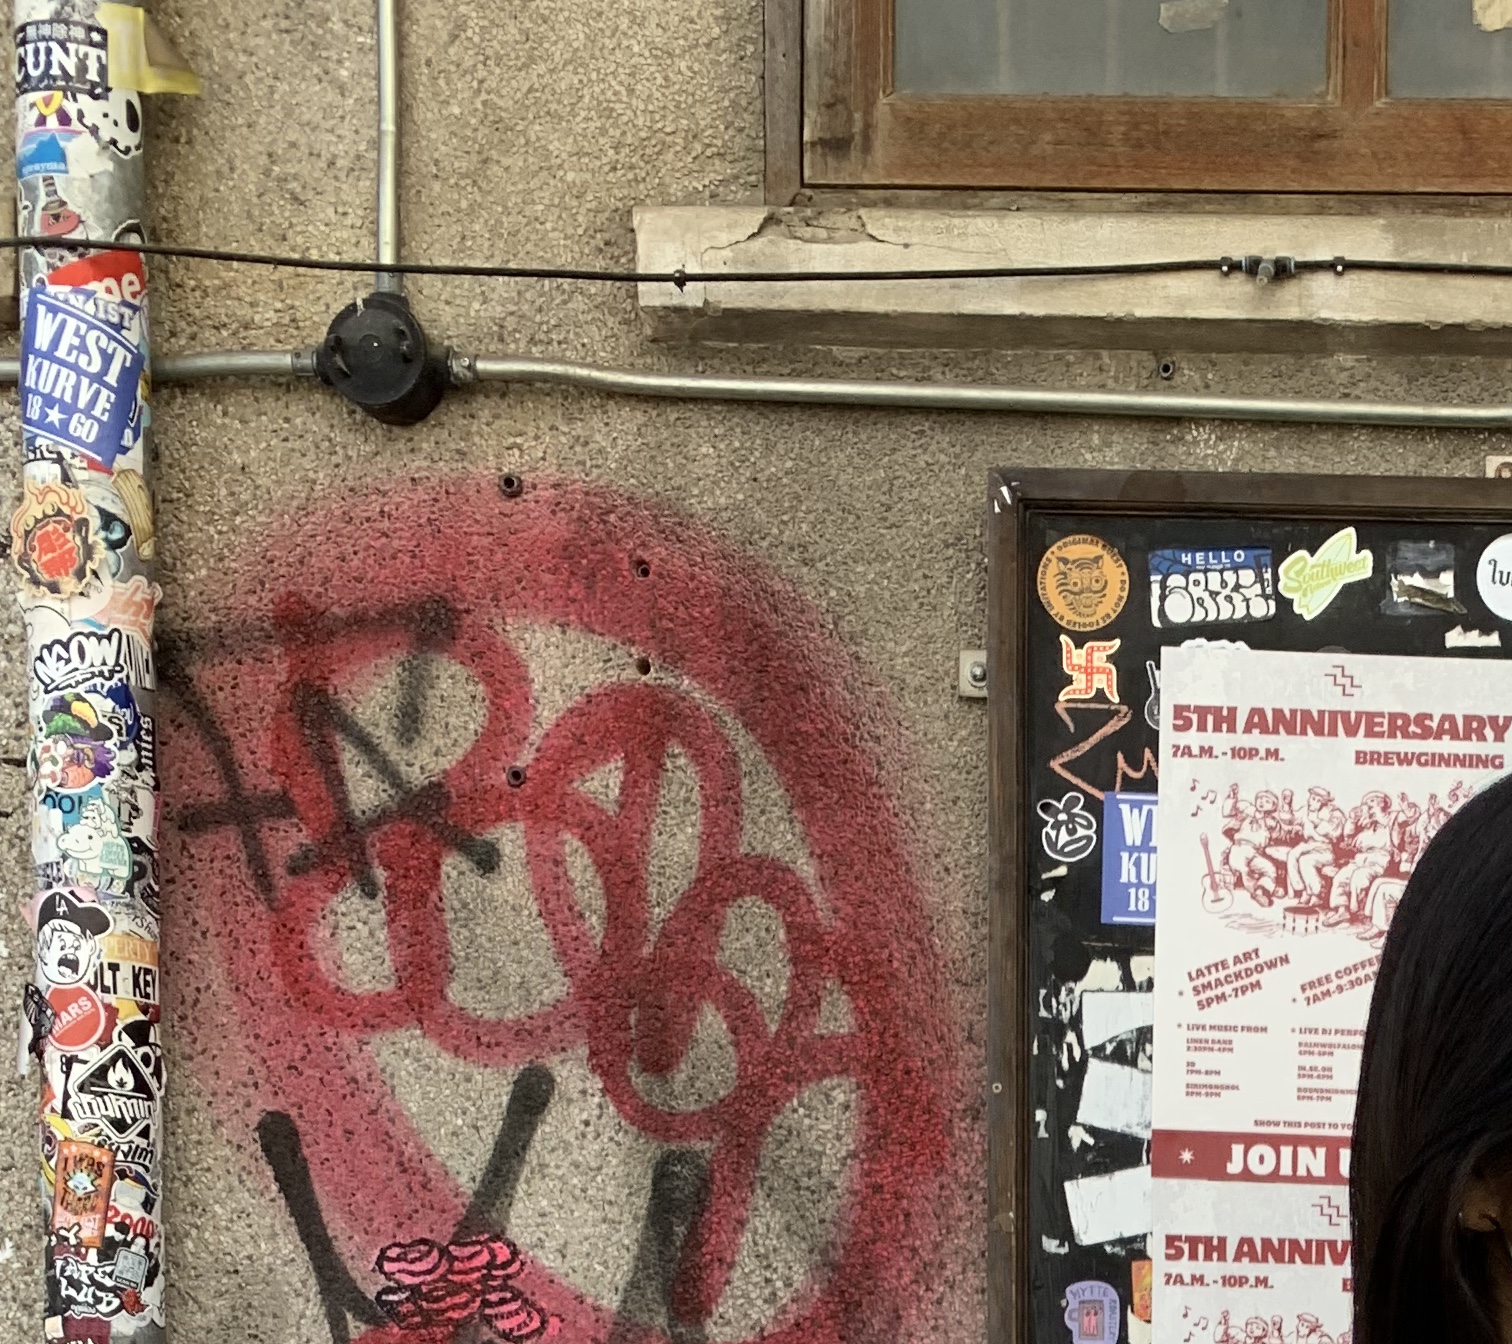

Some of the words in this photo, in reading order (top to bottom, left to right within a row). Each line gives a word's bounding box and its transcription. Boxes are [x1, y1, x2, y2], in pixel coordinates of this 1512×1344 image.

[15, 41, 108, 83] CUNT
[33, 303, 133, 388] WEST
[24, 353, 116, 423] KURVE
[25, 393, 43, 421] 18
[68, 412, 99, 444] 60
[1181, 549, 1246, 565] HELLO
[1283, 555, 1368, 595] Southwest
[1171, 703, 1238, 735] 5TH
[1354, 749, 1505, 770] BREWGINNING
[1186, 958, 1231, 983] LATTE
[1232, 947, 1261, 966] ART
[1191, 953, 1291, 998] SMACKDOWN
[131, 965, 157, 1003] KEY
[1196, 979, 1263, 1012] 5PM-7PM
[1299, 973, 1334, 995] FREE
[52, 996, 93, 1036] MARS
[1186, 1023, 1207, 1032] LIVE
[1208, 1024, 1239, 1033] MUSIC
[1240, 1025, 1268, 1034] FROM
[1299, 1027, 1319, 1035] LIVE
[1253, 1119, 1281, 1127] SHOW
[1283, 1120, 1301, 1128] THIS
[1304, 1121, 1326, 1129] POST
[1225, 1142, 1327, 1178] JOIN
[1164, 1234, 1228, 1263] 5TH
